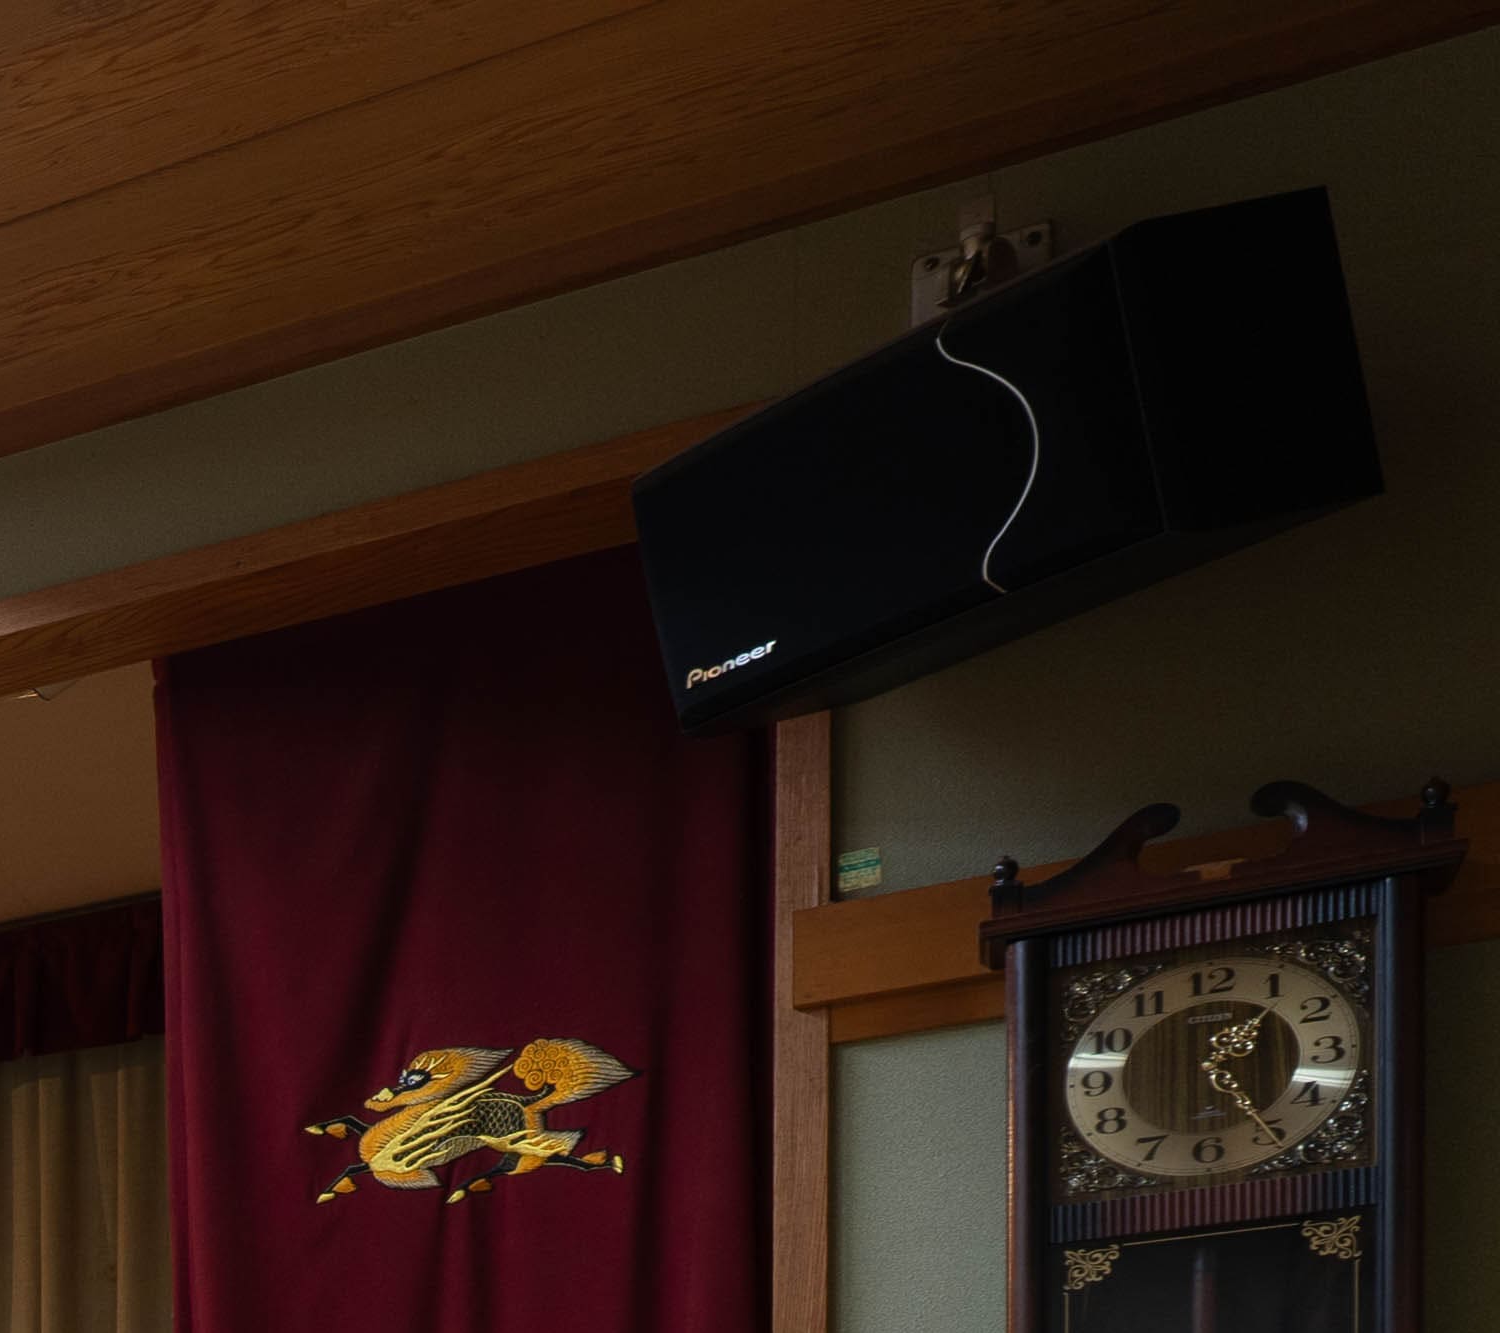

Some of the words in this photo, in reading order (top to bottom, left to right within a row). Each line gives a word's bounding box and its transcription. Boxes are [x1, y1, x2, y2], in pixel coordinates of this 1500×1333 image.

[686, 639, 777, 690] Pioneer
[1188, 966, 1236, 997] 12
[1262, 973, 1284, 999] 1
[1133, 990, 1168, 1019] 11
[1299, 996, 1331, 1024] 2
[1087, 1027, 1133, 1055] 10
[1311, 1035, 1346, 1064] 3
[1081, 1070, 1113, 1097] 9
[1290, 1080, 1325, 1107] 4
[1094, 1107, 1127, 1135] 8
[1252, 1118, 1287, 1147] 5
[1136, 1134, 1170, 1162] 7
[1191, 1136, 1226, 1164] 6
